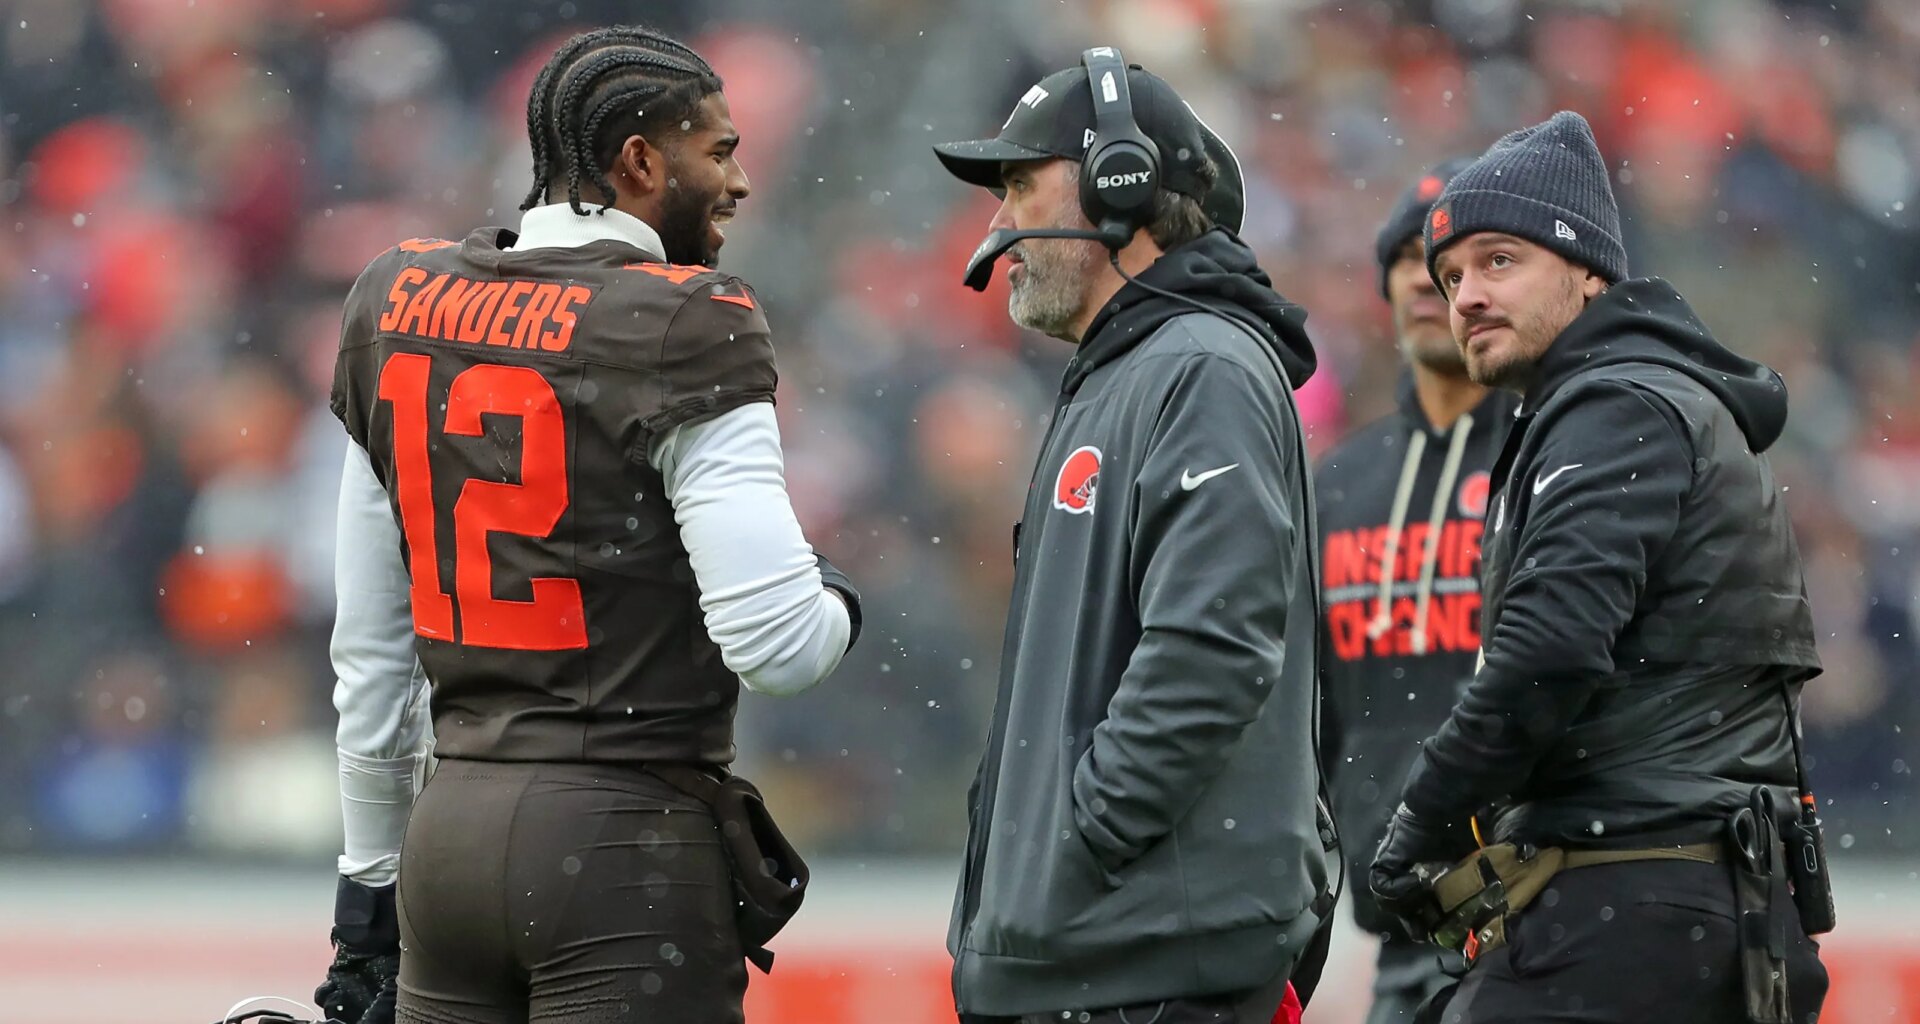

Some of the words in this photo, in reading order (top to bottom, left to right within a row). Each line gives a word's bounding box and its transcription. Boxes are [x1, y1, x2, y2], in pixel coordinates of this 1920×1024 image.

[1096, 170, 1151, 189] SONY
[380, 268, 591, 352] SANDERS
[379, 353, 589, 650] 12
